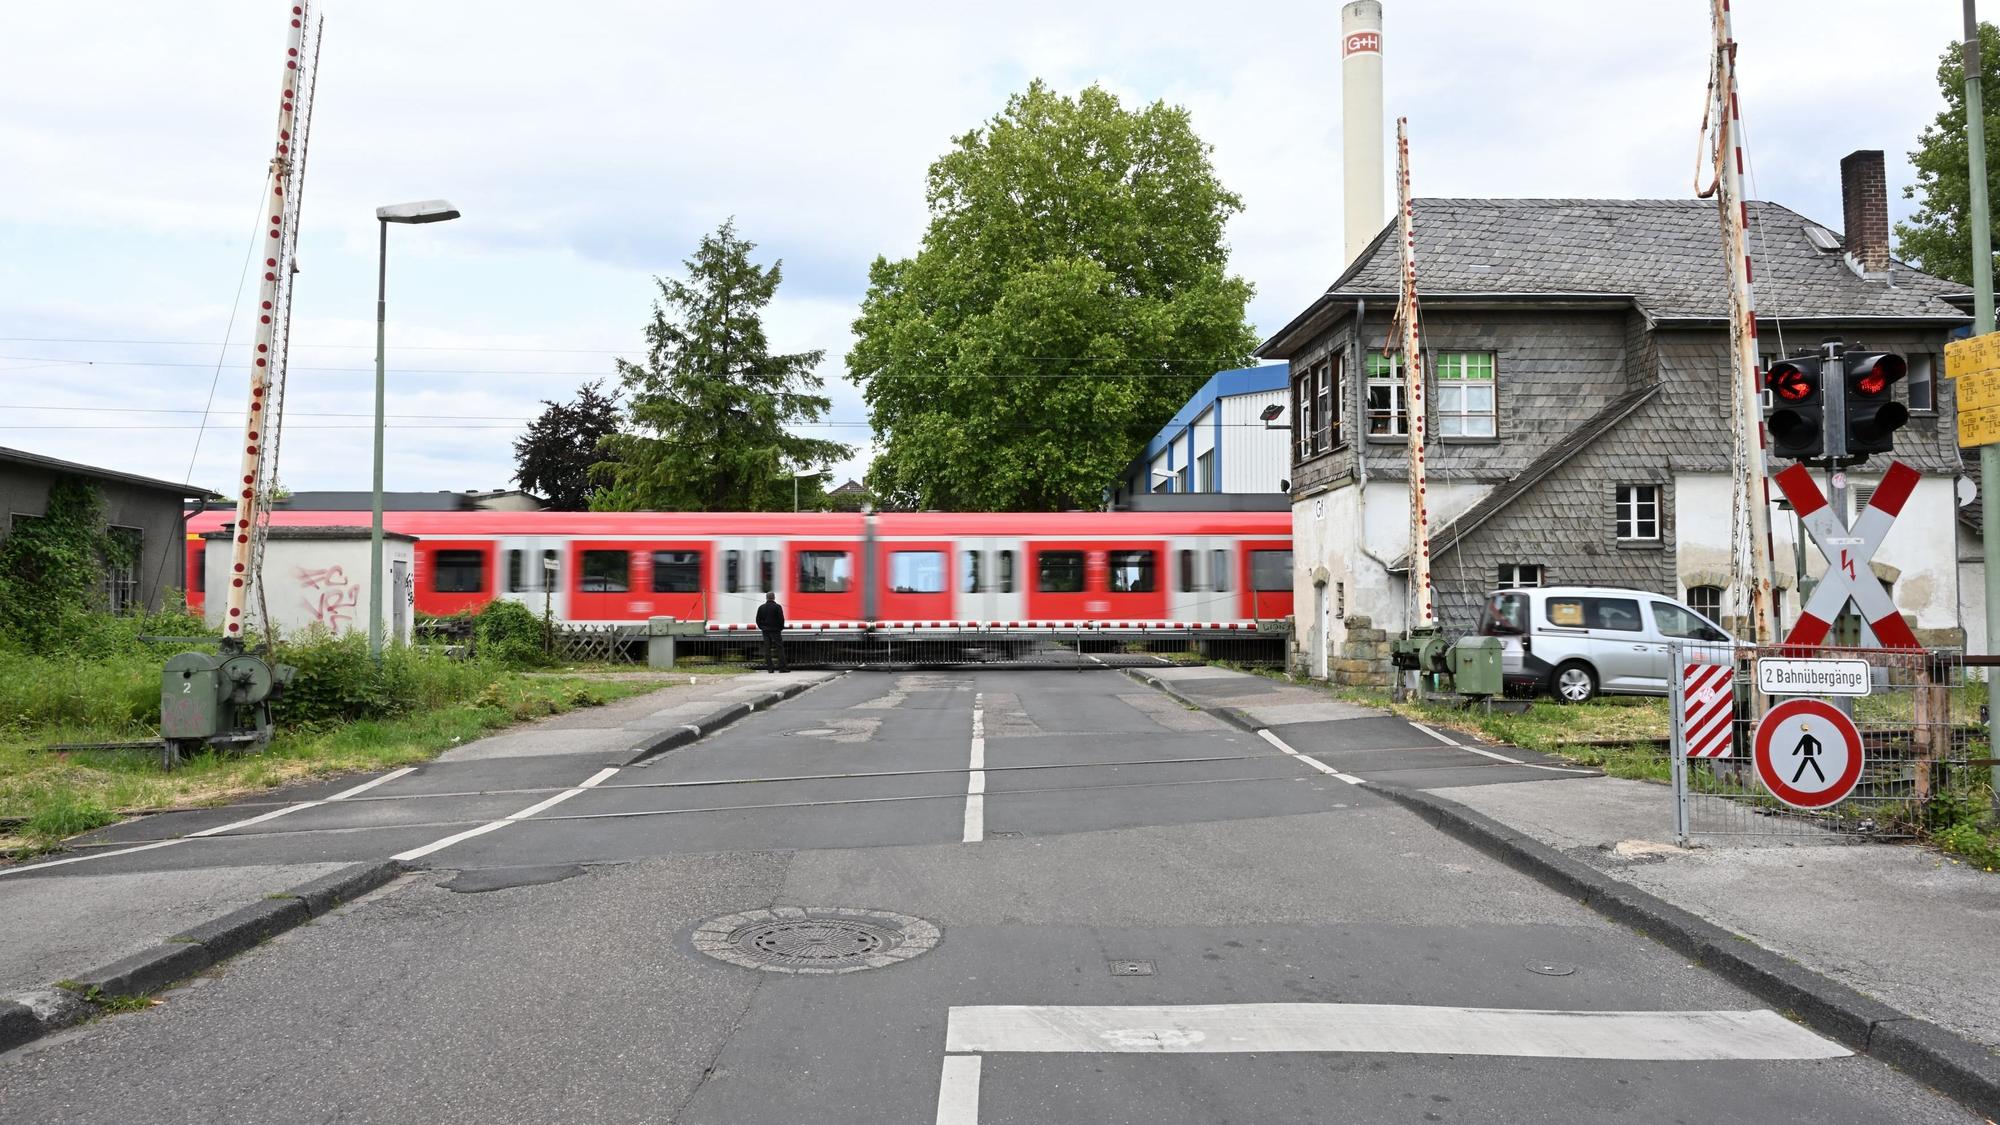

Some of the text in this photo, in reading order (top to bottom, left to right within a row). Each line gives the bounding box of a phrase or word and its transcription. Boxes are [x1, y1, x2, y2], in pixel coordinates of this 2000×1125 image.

[1348, 35, 1377, 50] G+H
[1766, 668, 1862, 687] 2 Bahnübergänge
[183, 682, 192, 694] 2
